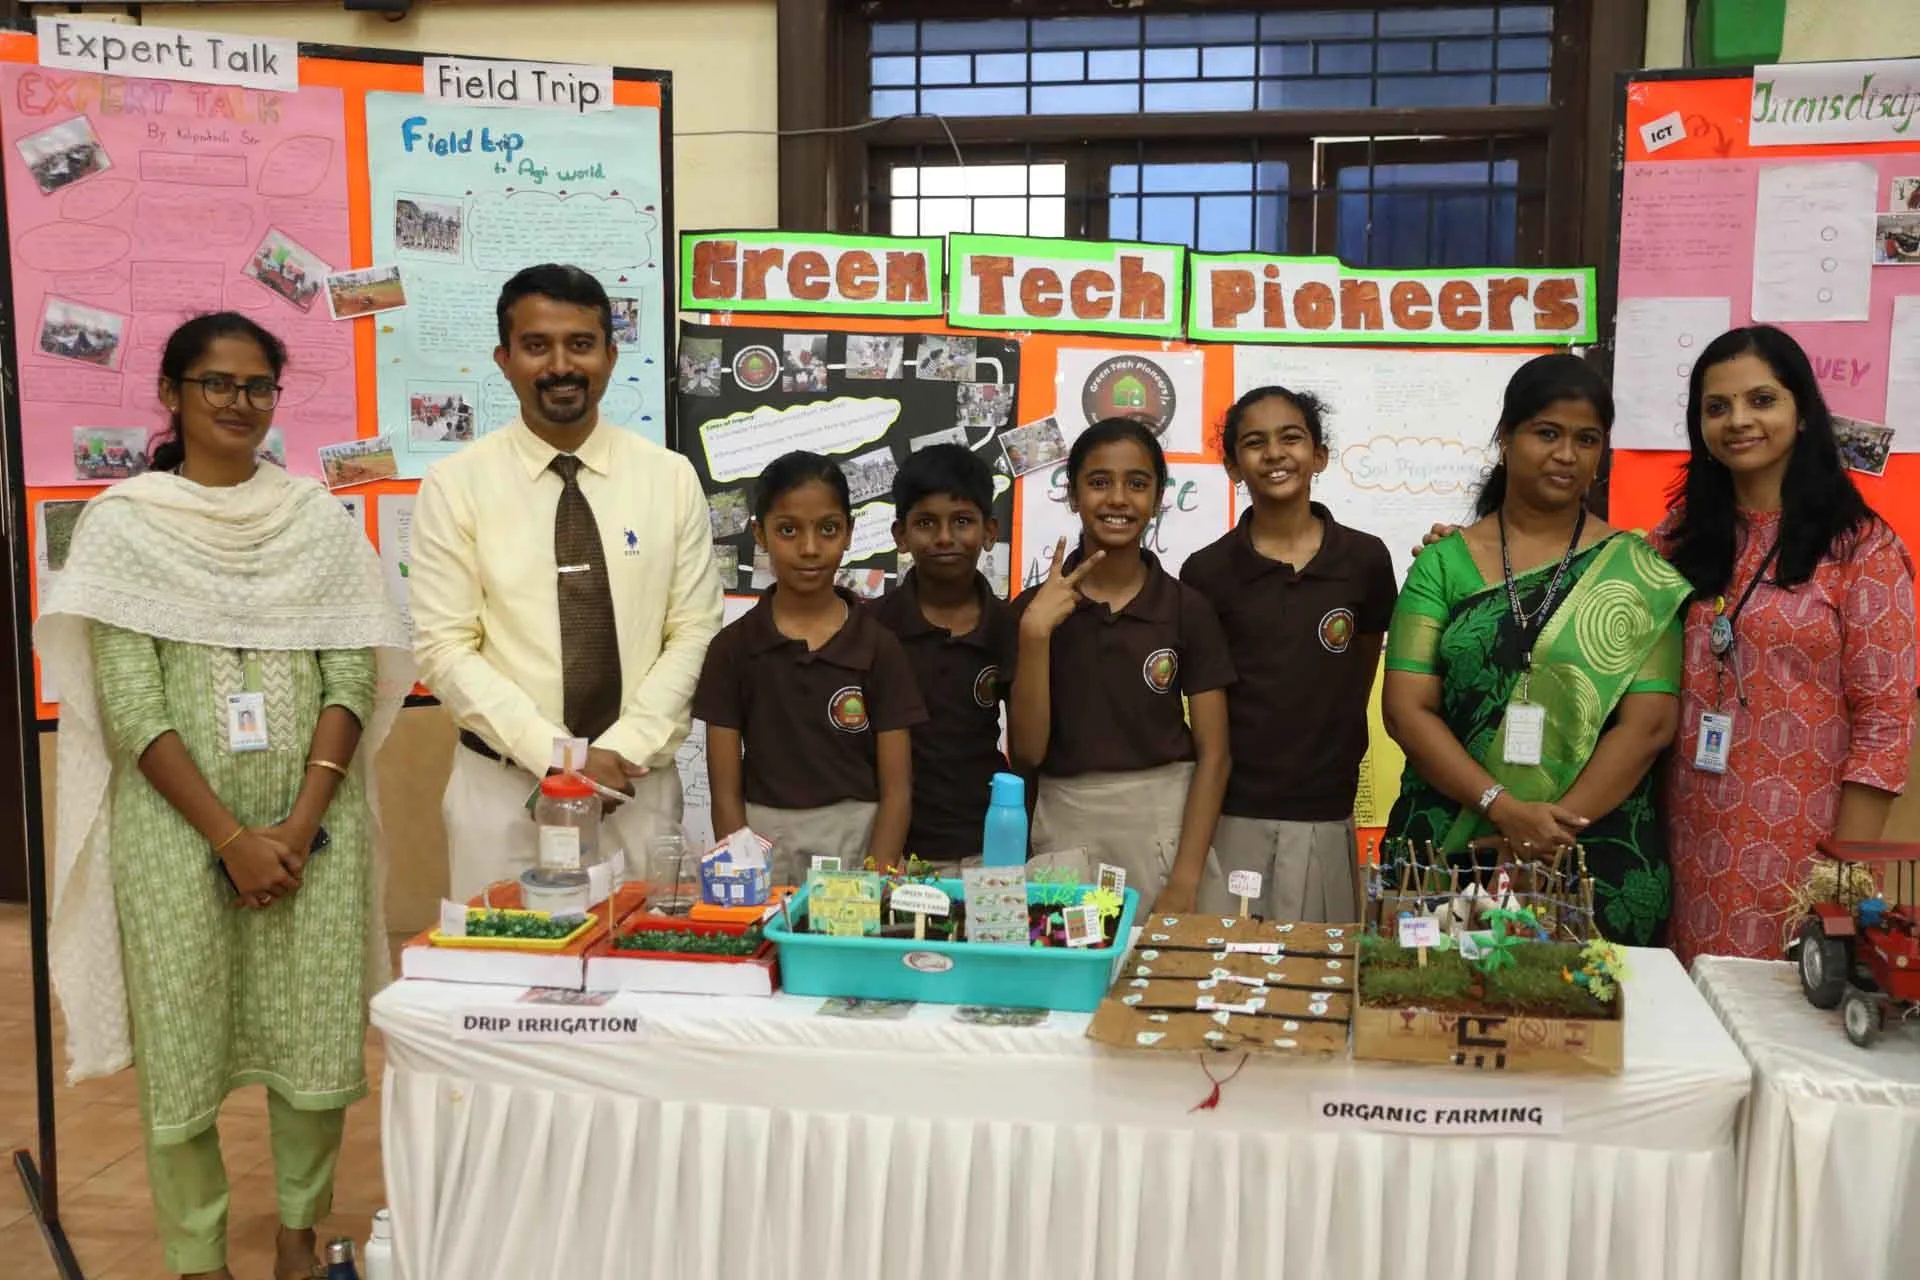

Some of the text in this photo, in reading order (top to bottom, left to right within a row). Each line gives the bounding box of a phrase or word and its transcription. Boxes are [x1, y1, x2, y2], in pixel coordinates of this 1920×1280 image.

[56, 23, 278, 75] Expert Talk
[17, 72, 283, 124] EXPERT TALK
[437, 64, 600, 112] Field Trip
[401, 116, 524, 162] Field trip
[557, 163, 606, 181] world
[692, 240, 1581, 331] Green Tech Pioneers
[1089, 368, 1112, 393] Green
[1109, 360, 1135, 372] Tech
[1816, 355, 1871, 387] VEY
[463, 1014, 638, 1035] DRIP IRRIGATION
[1322, 1102, 1544, 1126] ORGANIC FARMING
